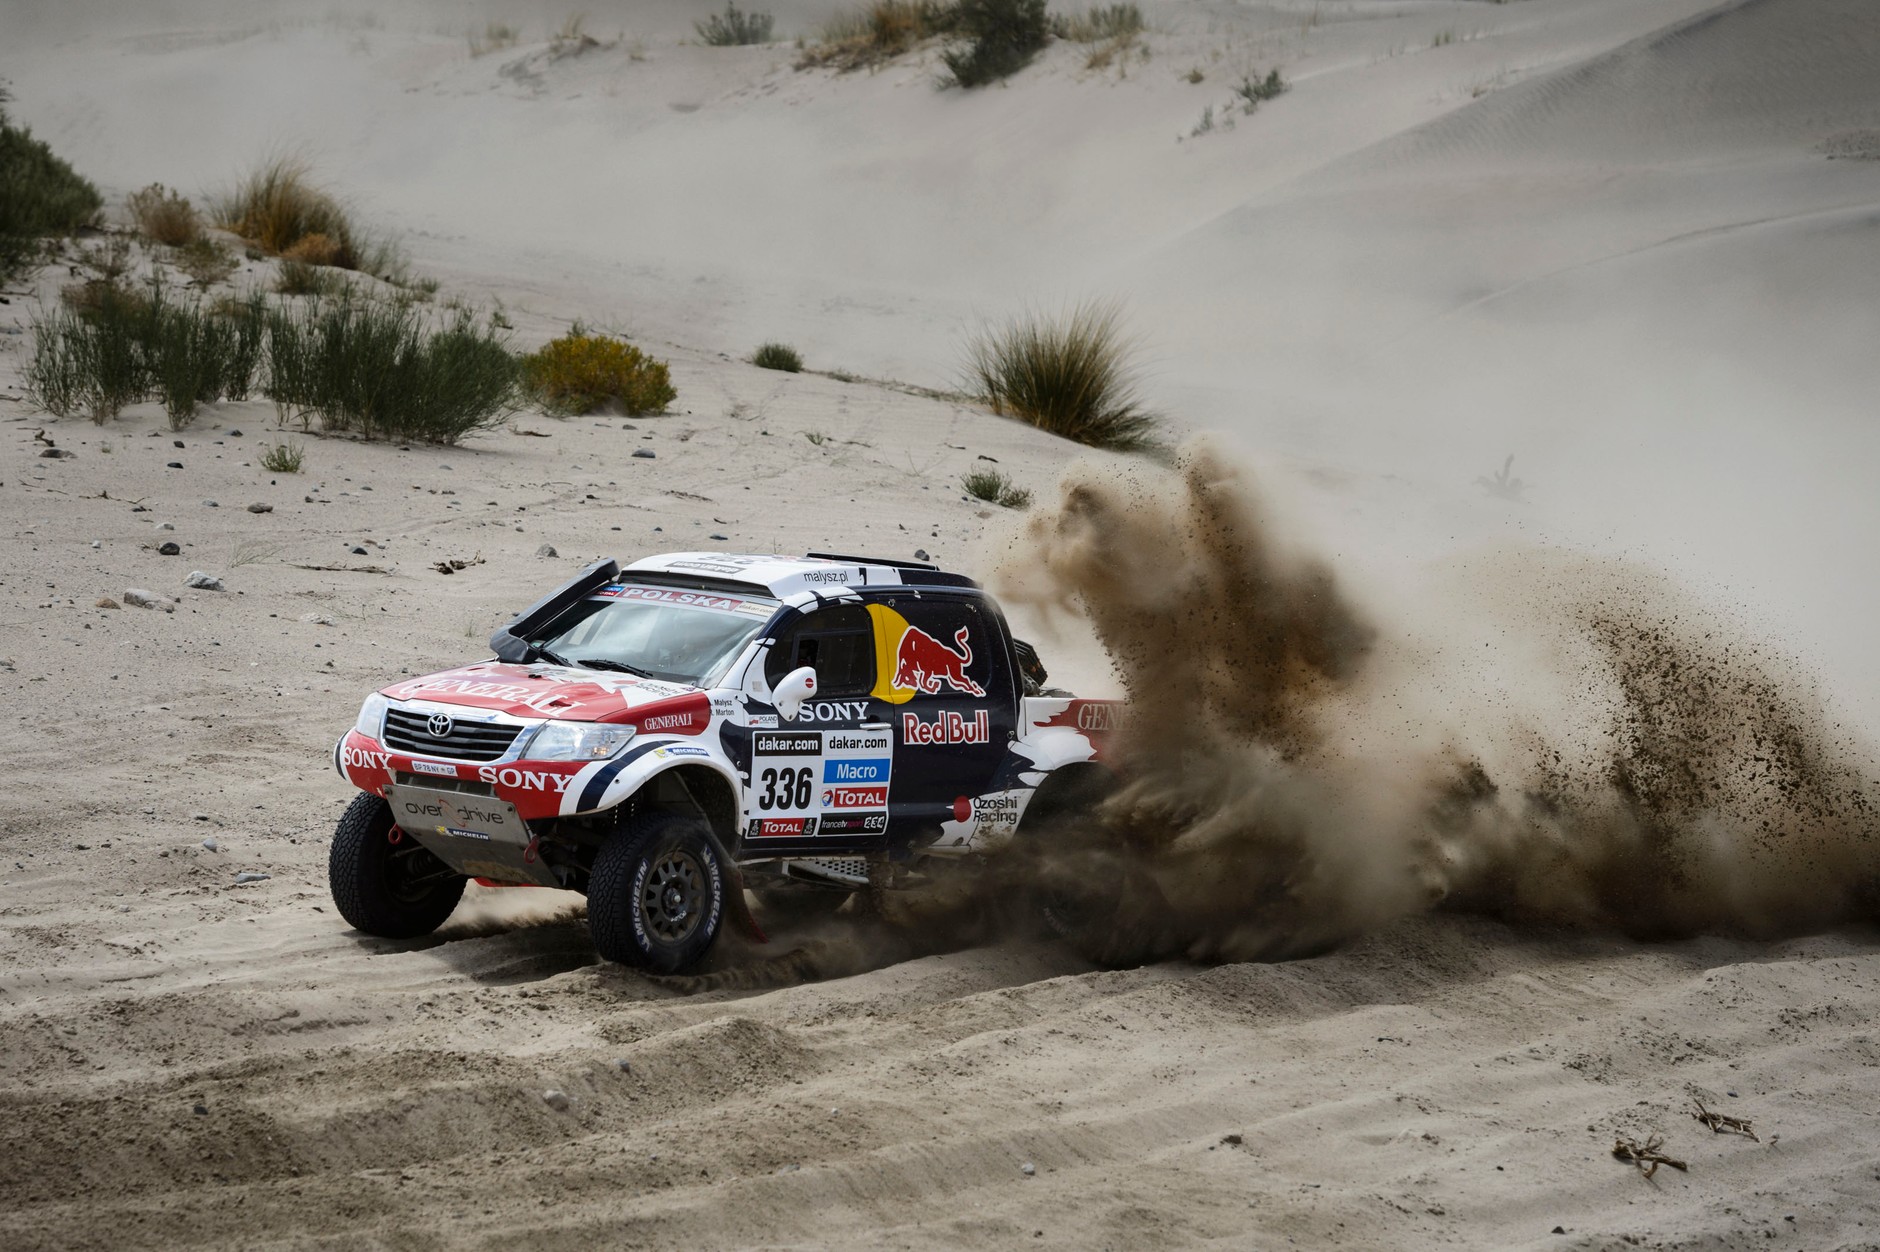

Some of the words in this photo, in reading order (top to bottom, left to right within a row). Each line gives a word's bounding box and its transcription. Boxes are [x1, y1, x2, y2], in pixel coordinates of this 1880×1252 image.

[803, 570, 849, 584] malysz.pl
[622, 588, 732, 611] POLSKA
[399, 678, 588, 718] GENERALI
[715, 709, 735, 717] Marton
[799, 701, 869, 722] SONY
[645, 713, 693, 731] GENERALI
[903, 711, 946, 745] Red
[947, 709, 989, 744] Bull
[758, 737, 819, 751] dakar.com
[829, 736, 887, 749] dakar.com
[343, 746, 392, 770] SONY
[836, 763, 878, 779] Macro
[478, 766, 576, 793] SONY
[759, 767, 814, 811] 336
[836, 790, 884, 805] TOTAL
[973, 796, 1018, 809] Ozoshi
[405, 802, 443, 817] over
[973, 810, 1018, 825] Racing
[452, 830, 489, 840] MICHELIN
[763, 821, 802, 833] TOTAL
[632, 860, 648, 936] MICHELIN
[706, 861, 721, 937] MICHELIN
